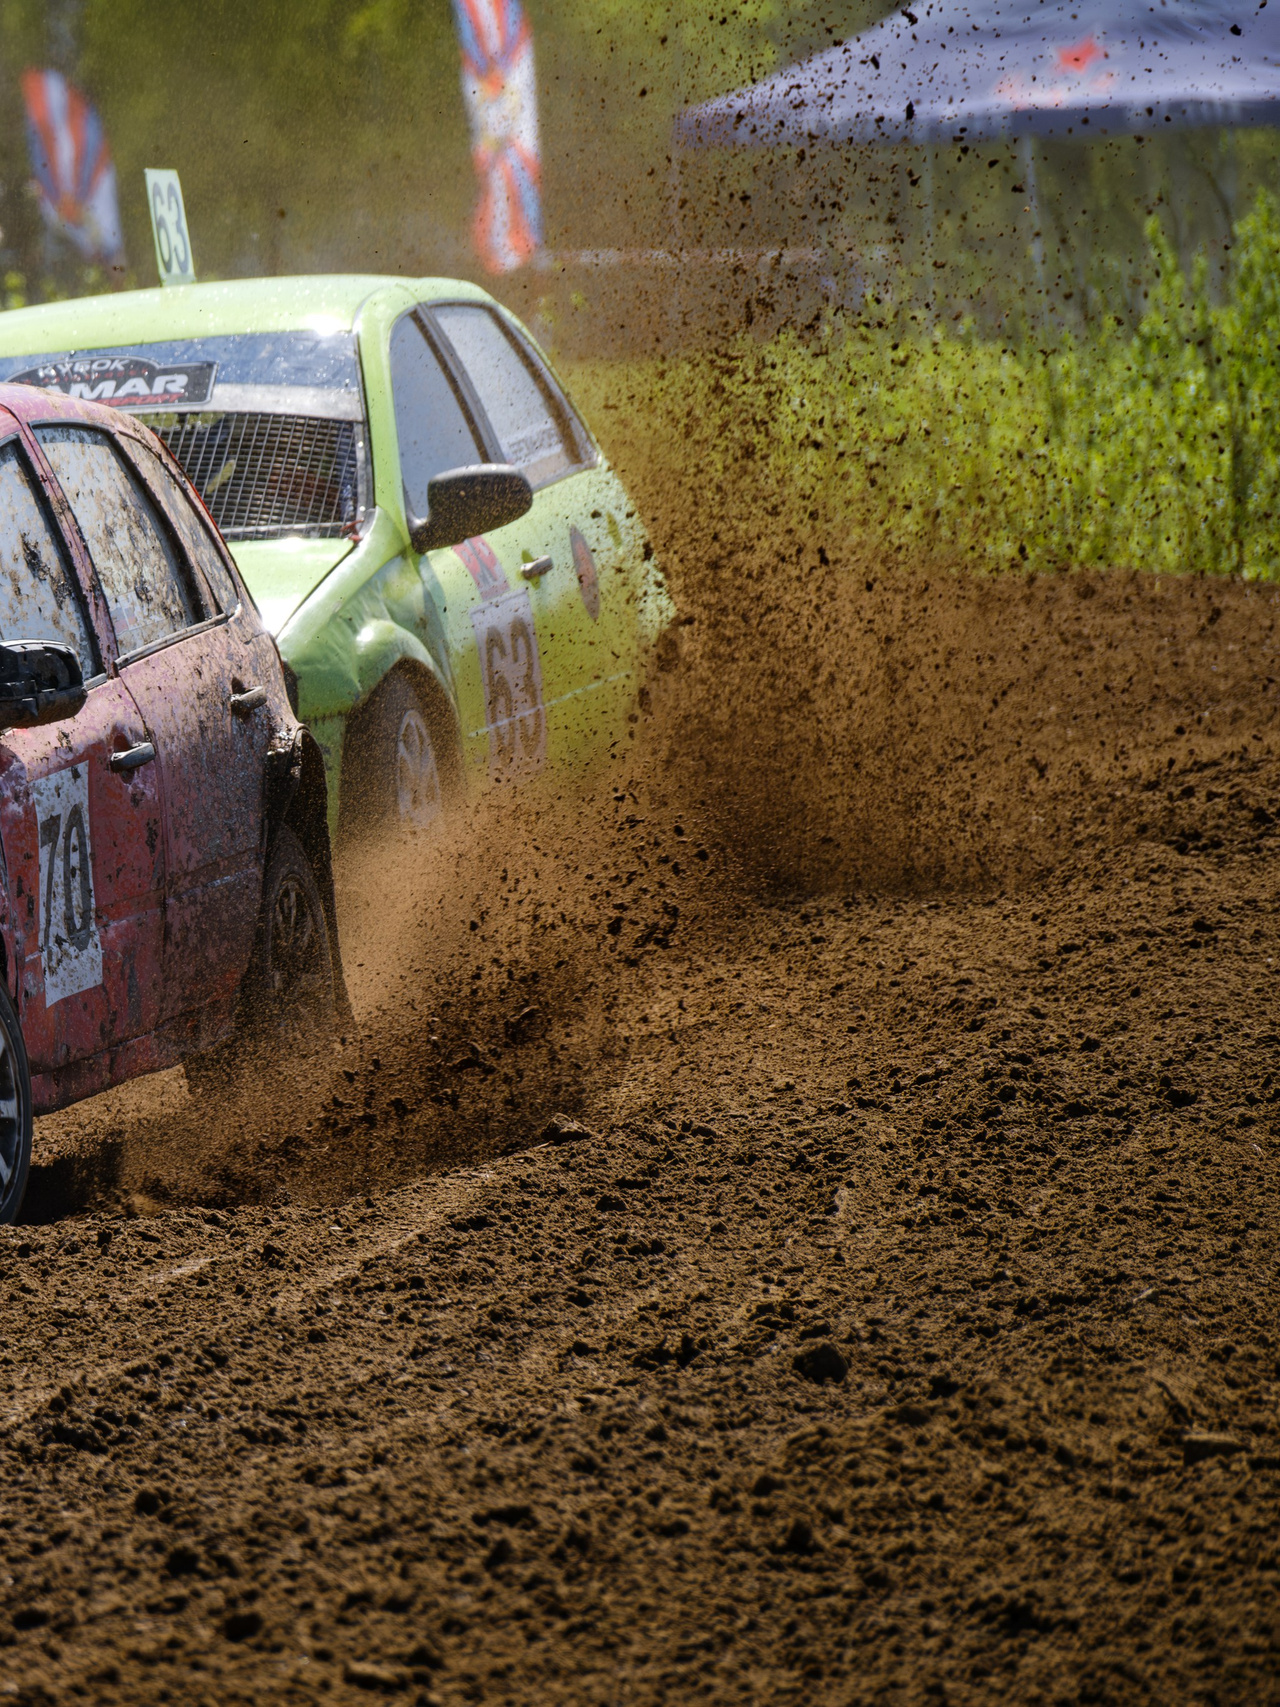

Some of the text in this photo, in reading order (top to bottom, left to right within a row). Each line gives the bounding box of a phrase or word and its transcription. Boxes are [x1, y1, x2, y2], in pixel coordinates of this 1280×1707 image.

[152, 182, 189, 274] 63
[485, 615, 545, 758] 63
[39, 803, 92, 954] 70
